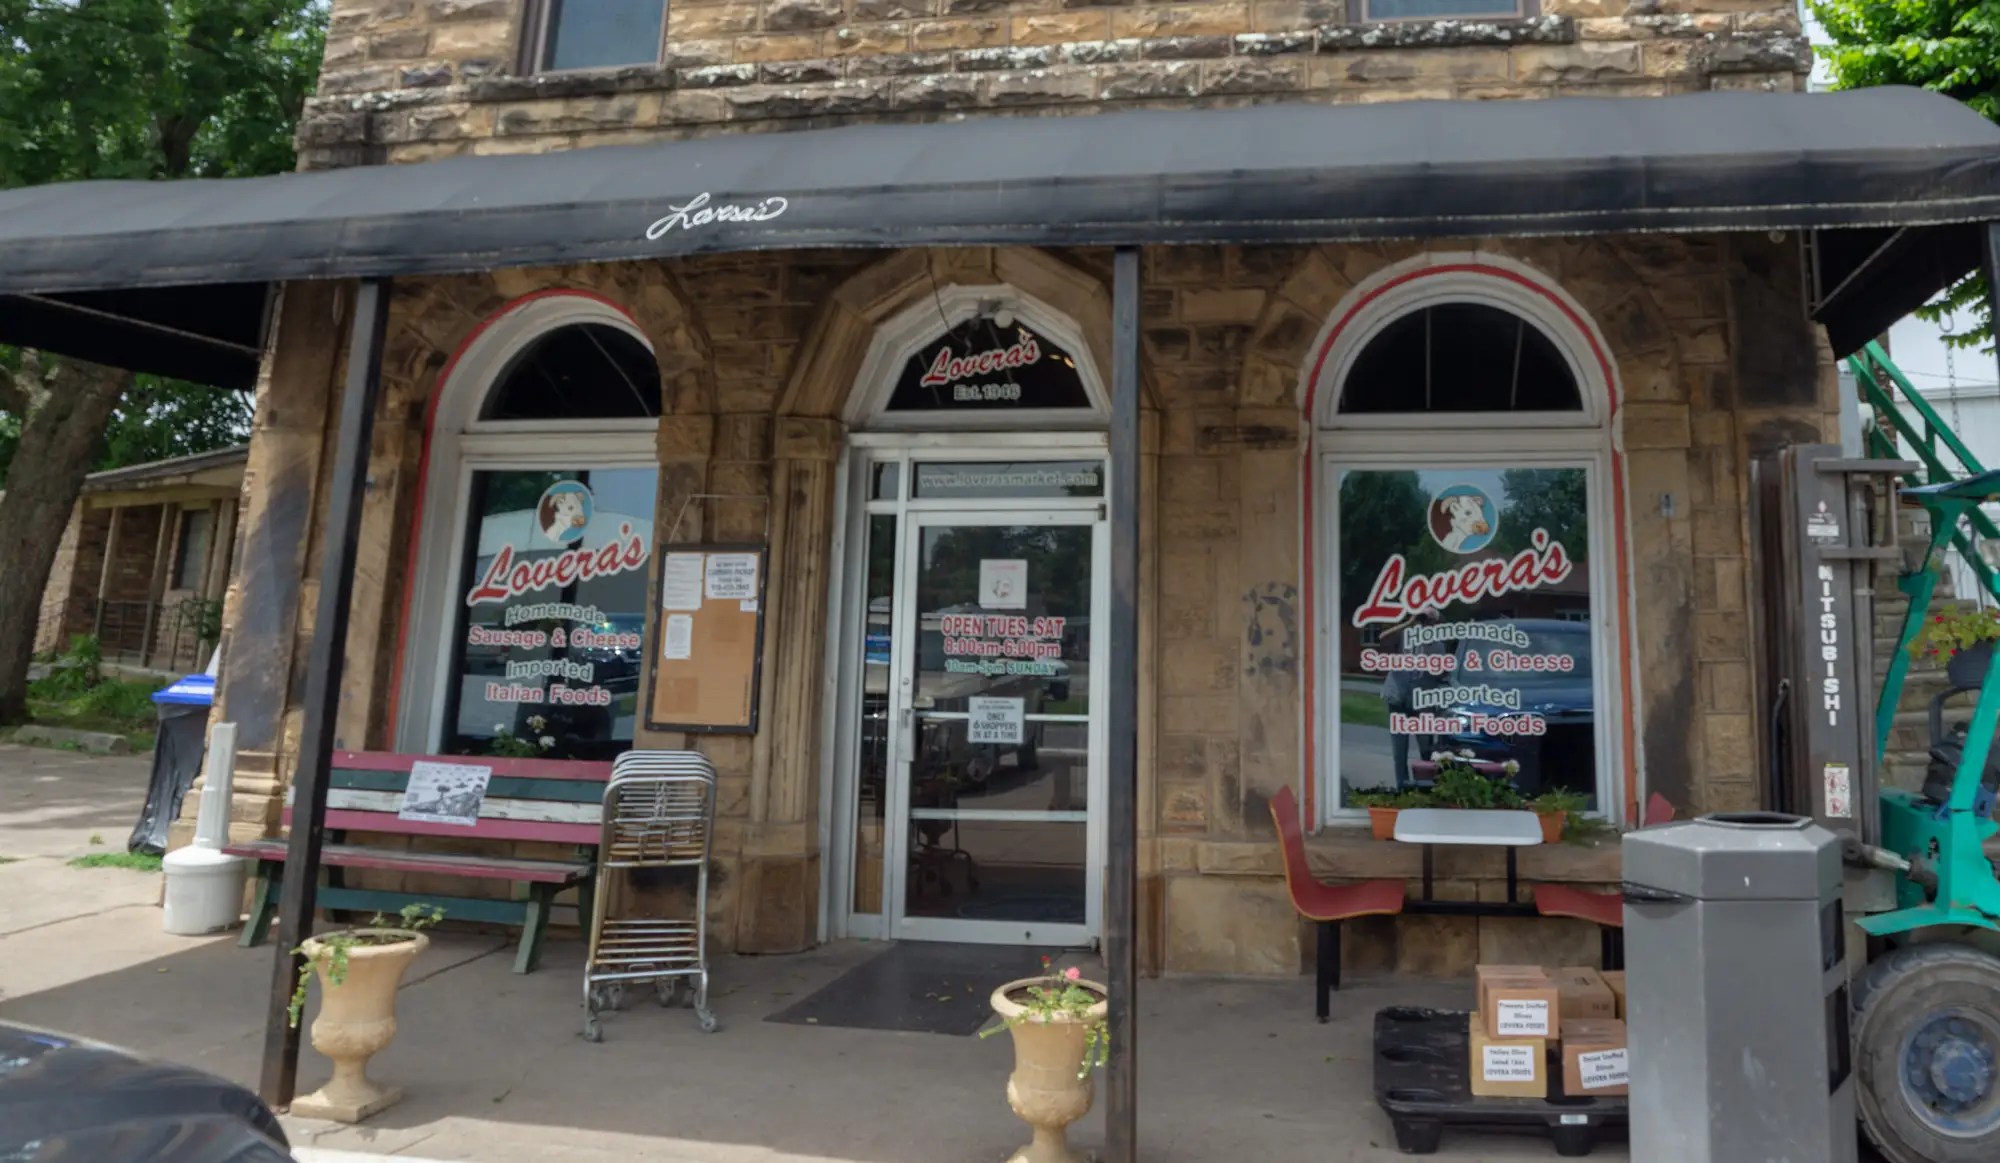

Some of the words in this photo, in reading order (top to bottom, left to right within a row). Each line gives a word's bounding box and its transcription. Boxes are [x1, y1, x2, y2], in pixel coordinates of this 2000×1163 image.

[921, 333, 1041, 387] Lovera's
[954, 384, 982, 400] Est.
[467, 523, 649, 606] Lovera's
[1353, 528, 1572, 628] Lovera's
[505, 603, 607, 626] Homemade
[941, 615, 984, 637] OPEN
[469, 626, 546, 648] Sausage
[551, 628, 566, 647] &
[571, 628, 640, 648] Cheese
[1404, 621, 1529, 648] Homemade
[1818, 565, 1840, 726] MITSUBISHI
[506, 658, 593, 682] Imported
[1007, 661, 1056, 676] SUNDAY
[1360, 649, 1457, 673] Sausage
[1464, 652, 1482, 671] &
[1489, 651, 1574, 671] Cheese
[485, 683, 543, 702] Italian
[550, 685, 611, 704] Foods
[1413, 685, 1520, 709] Imported
[1390, 714, 1460, 734] Italian
[1471, 715, 1546, 735] Foods
